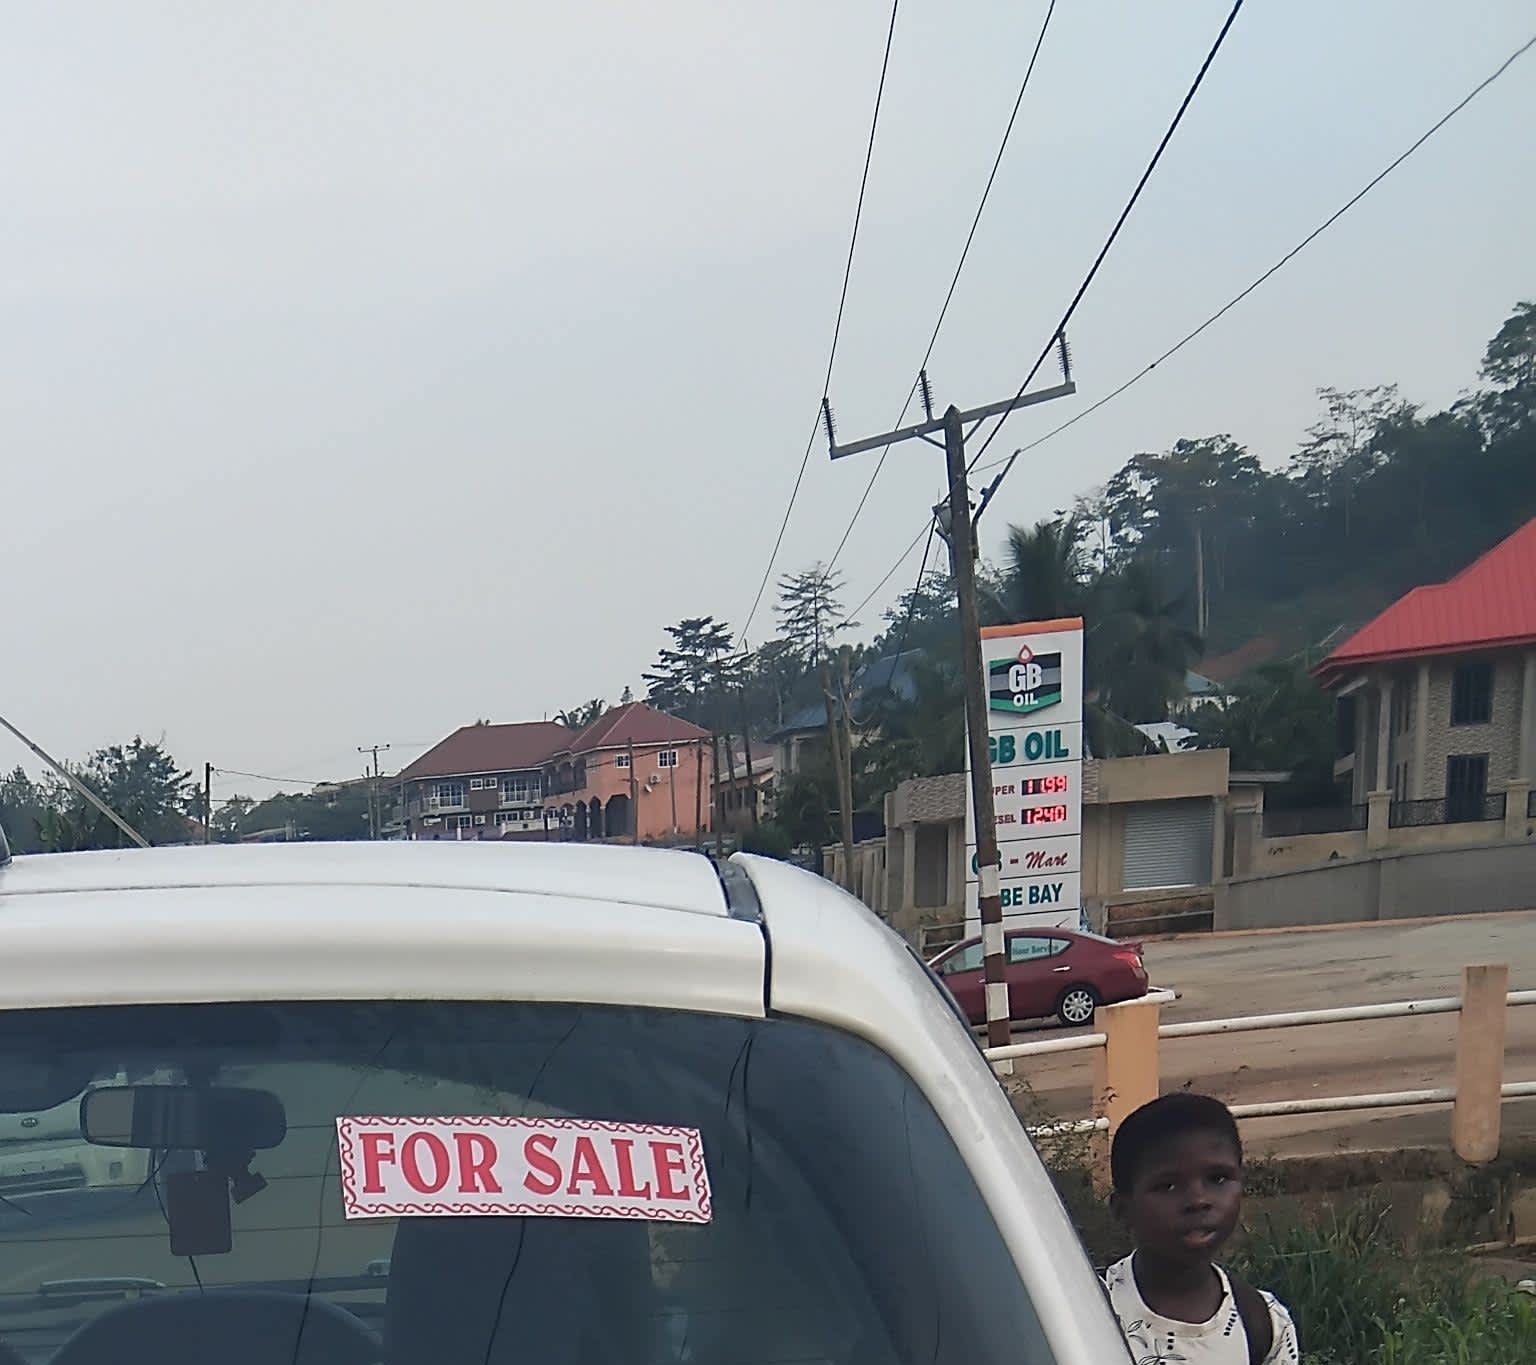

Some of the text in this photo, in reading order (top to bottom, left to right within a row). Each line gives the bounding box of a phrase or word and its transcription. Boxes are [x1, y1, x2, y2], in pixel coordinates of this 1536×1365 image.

[1008, 663, 1042, 693] GB
[1013, 692, 1039, 707] OIL
[1025, 729, 1069, 761] OIL
[992, 785, 1016, 796] PER
[1029, 883, 1063, 905] BAY
[359, 1131, 691, 1201] FOR SALE
